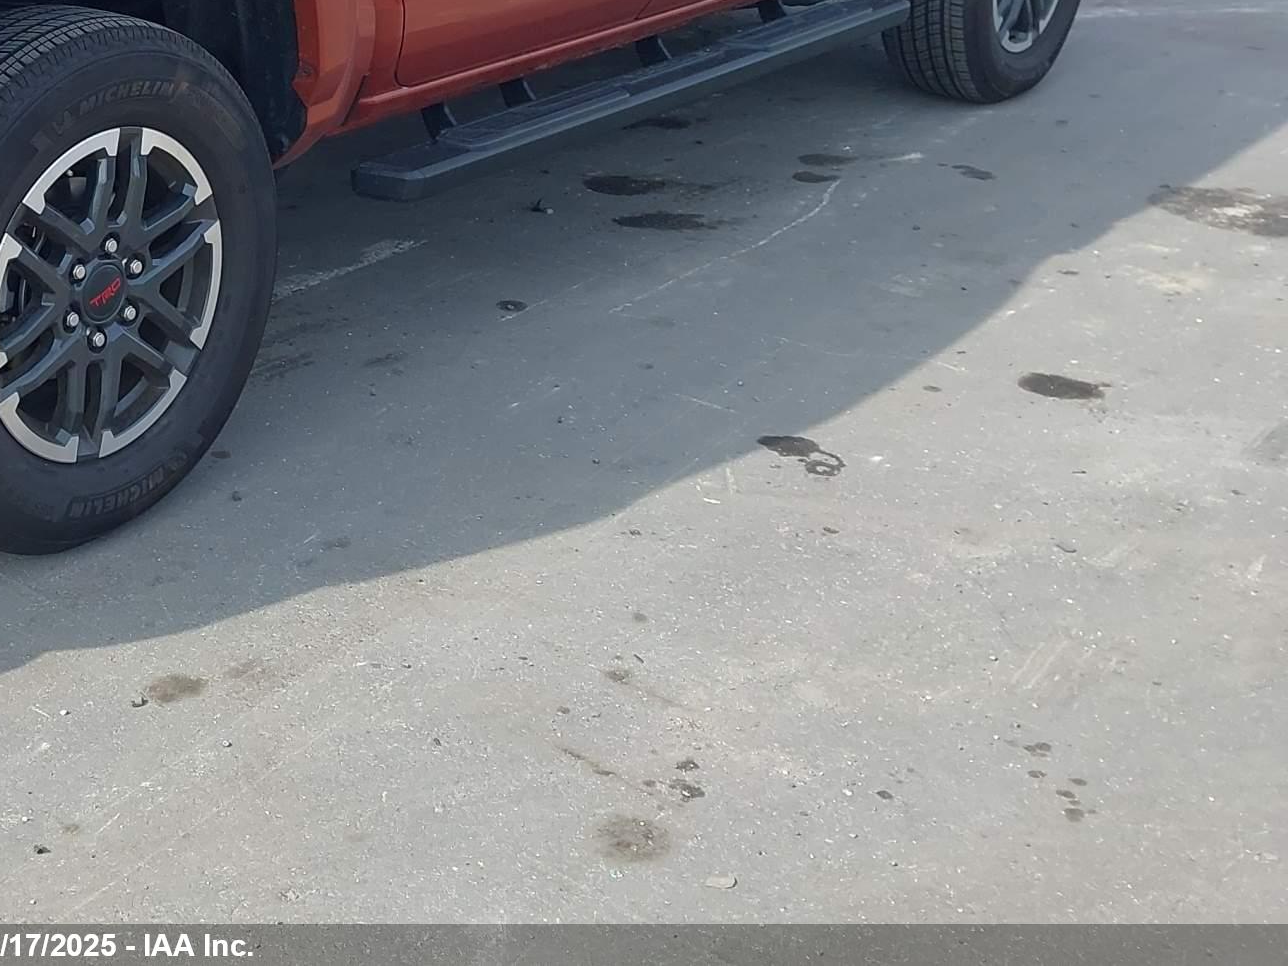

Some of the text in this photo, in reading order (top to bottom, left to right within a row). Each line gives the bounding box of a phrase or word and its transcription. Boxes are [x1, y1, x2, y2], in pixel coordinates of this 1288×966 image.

[79, 80, 176, 115] MICHELIN
[89, 277, 121, 307] TRD
[68, 466, 165, 519] MICHELIN
